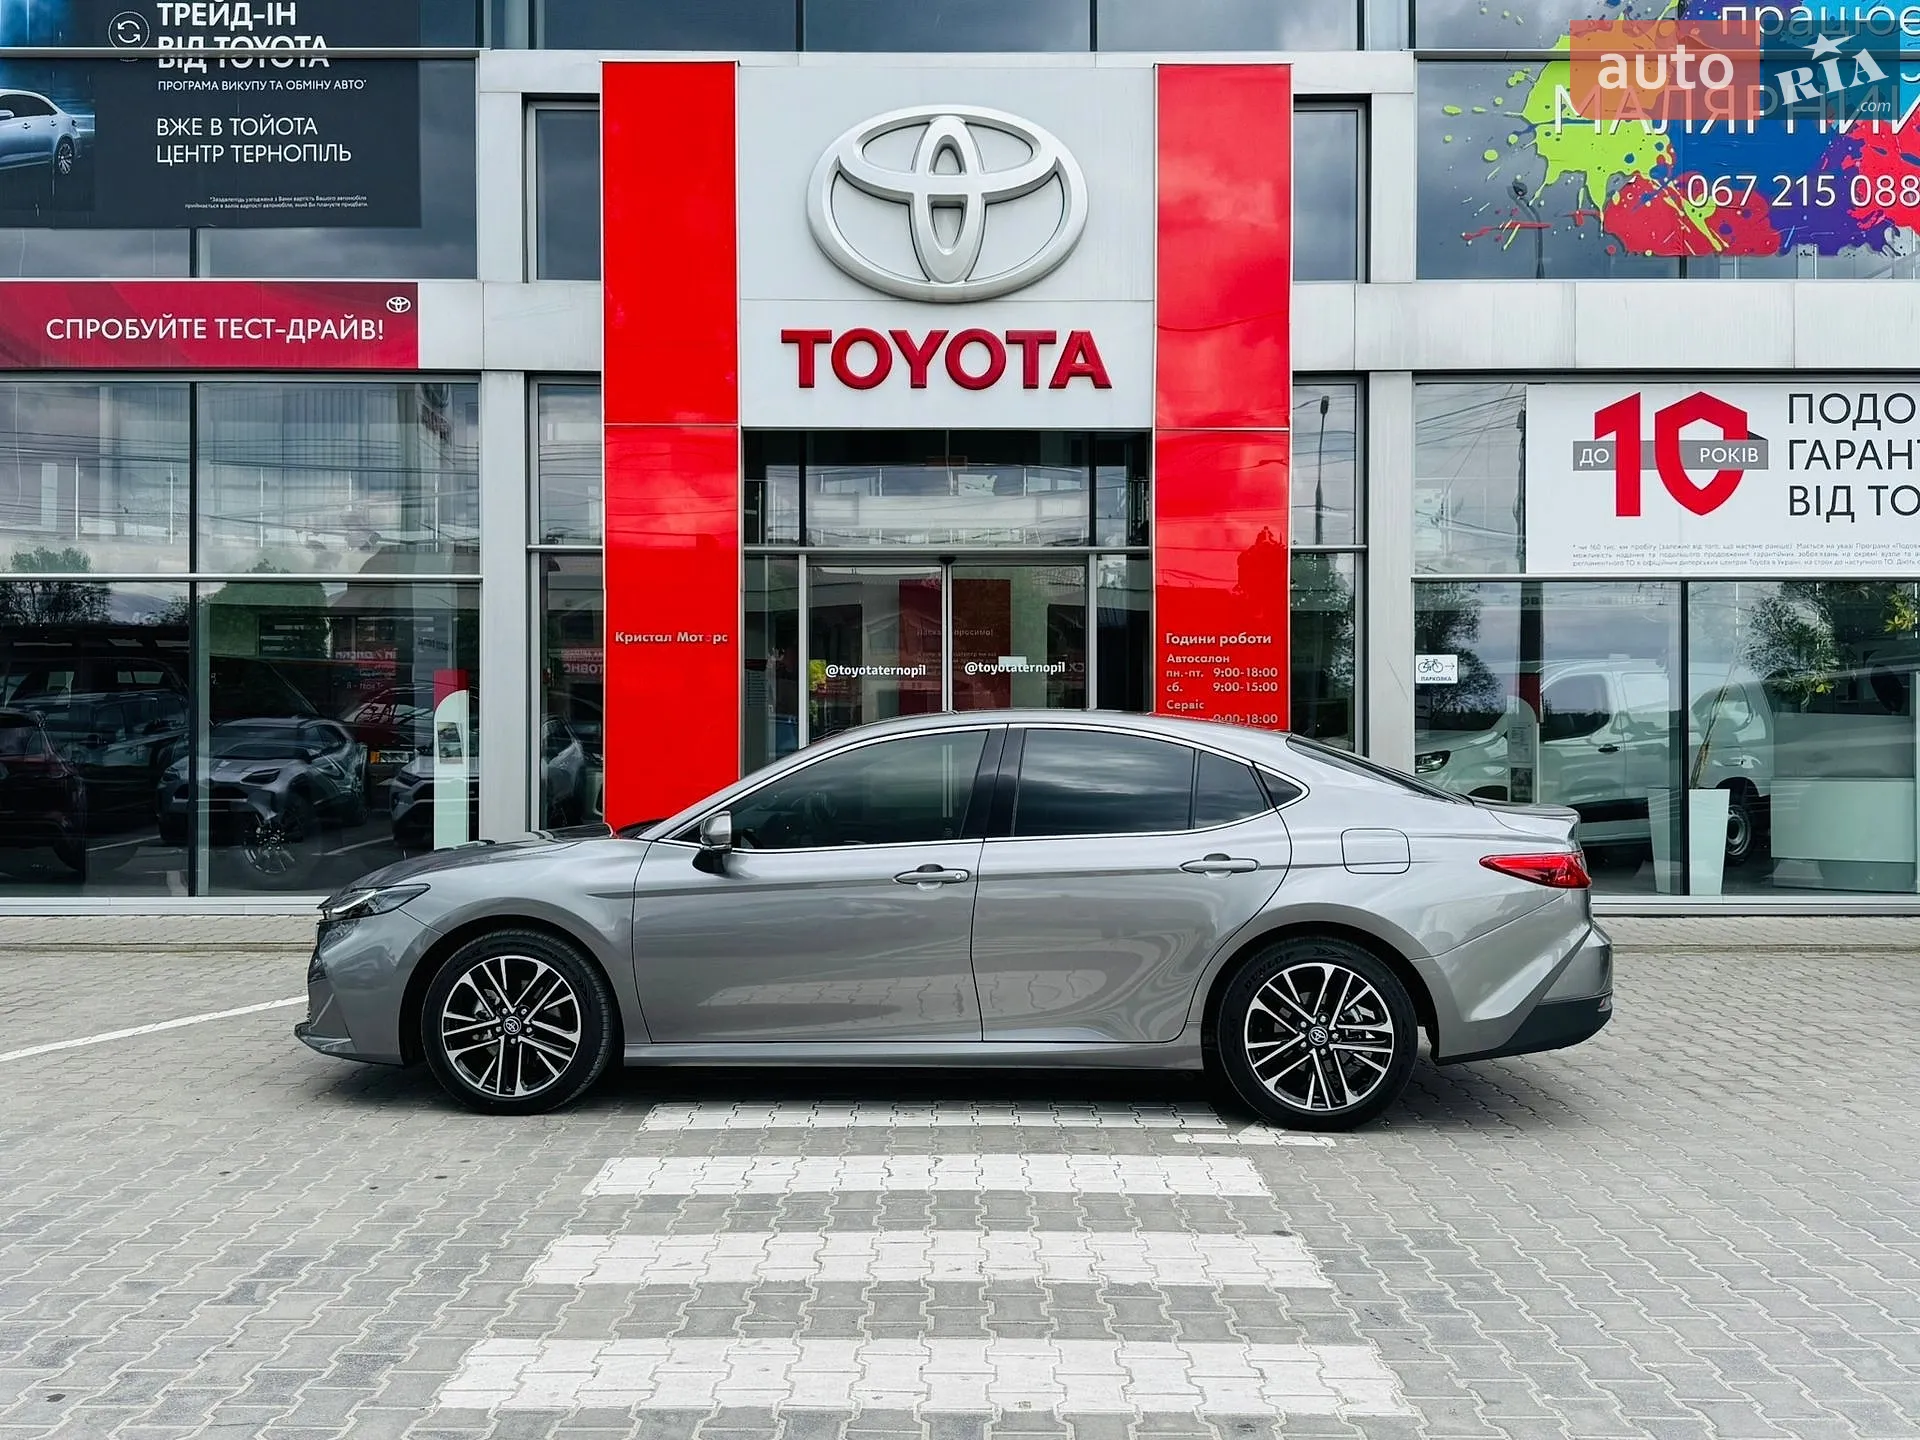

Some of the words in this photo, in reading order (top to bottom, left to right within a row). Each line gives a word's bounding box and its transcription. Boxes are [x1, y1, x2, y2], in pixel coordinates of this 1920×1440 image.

[157, 0, 297, 31] ТРЕЙД-ІН
[158, 36, 207, 73] ВІД
[157, 80, 219, 92] ПРОГРАМА
[221, 80, 269, 92] ВИКУПУ
[269, 80, 284, 91] ТА
[285, 79, 332, 91] ОБМІНУ
[156, 117, 203, 136] ВЖЕ
[210, 117, 223, 136] В
[229, 113, 318, 136] ТОЙОТА
[156, 145, 225, 167] ЦЕНТР
[230, 143, 352, 163] ТЕРНОПІЛЬ
[1687, 174, 1758, 208] 067
[1771, 174, 1837, 208] 215
[46, 313, 208, 341] СПРОБУЙТЕ
[214, 314, 384, 344] ТЕСТ-ДРАЙВ!
[781, 327, 1112, 390] TOYOTA
[1579, 449, 1610, 467] ДО
[1594, 391, 1748, 517] 10
[1699, 447, 1759, 464] РОКІВ
[1788, 439, 1920, 471] ГАРАН
[1789, 485, 1856, 523] ВІД
[615, 632, 672, 645] Кристал
[1165, 632, 1216, 646] Години
[1220, 632, 1272, 647] роботи
[1166, 653, 1230, 663] Автосалон
[825, 664, 927, 678] @toyotaternopil
[964, 661, 1066, 675] @toyotaternopil
[1213, 667, 1278, 678] 9:00-18:00
[1166, 681, 1184, 692] сб.
[1213, 681, 1278, 692] 9:00-15:00
[1166, 699, 1205, 712] Сервіс
